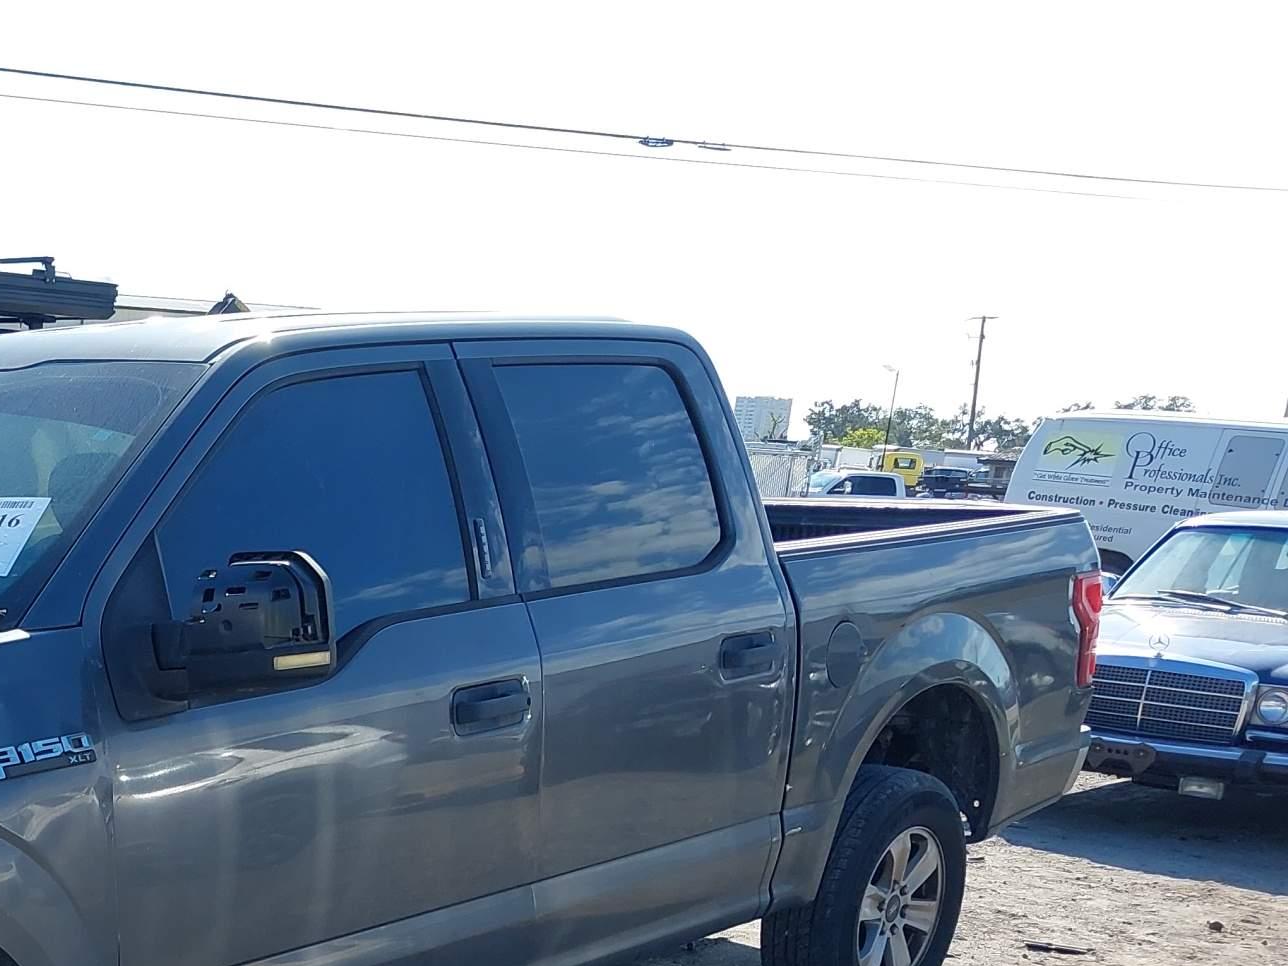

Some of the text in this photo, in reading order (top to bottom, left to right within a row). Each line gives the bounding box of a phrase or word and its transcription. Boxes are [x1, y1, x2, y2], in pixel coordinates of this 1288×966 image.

[1126, 432, 1187, 459] Office
[1123, 451, 1241, 487] Professionals Inc.
[1027, 490, 1096, 507] Construction
[1107, 498, 1157, 514] Pressure
[1124, 481, 1183, 497] Property
[1187, 487, 1278, 506] Maintenance
[1093, 534, 1114, 543] ured
[68, 753, 92, 764] XLT
